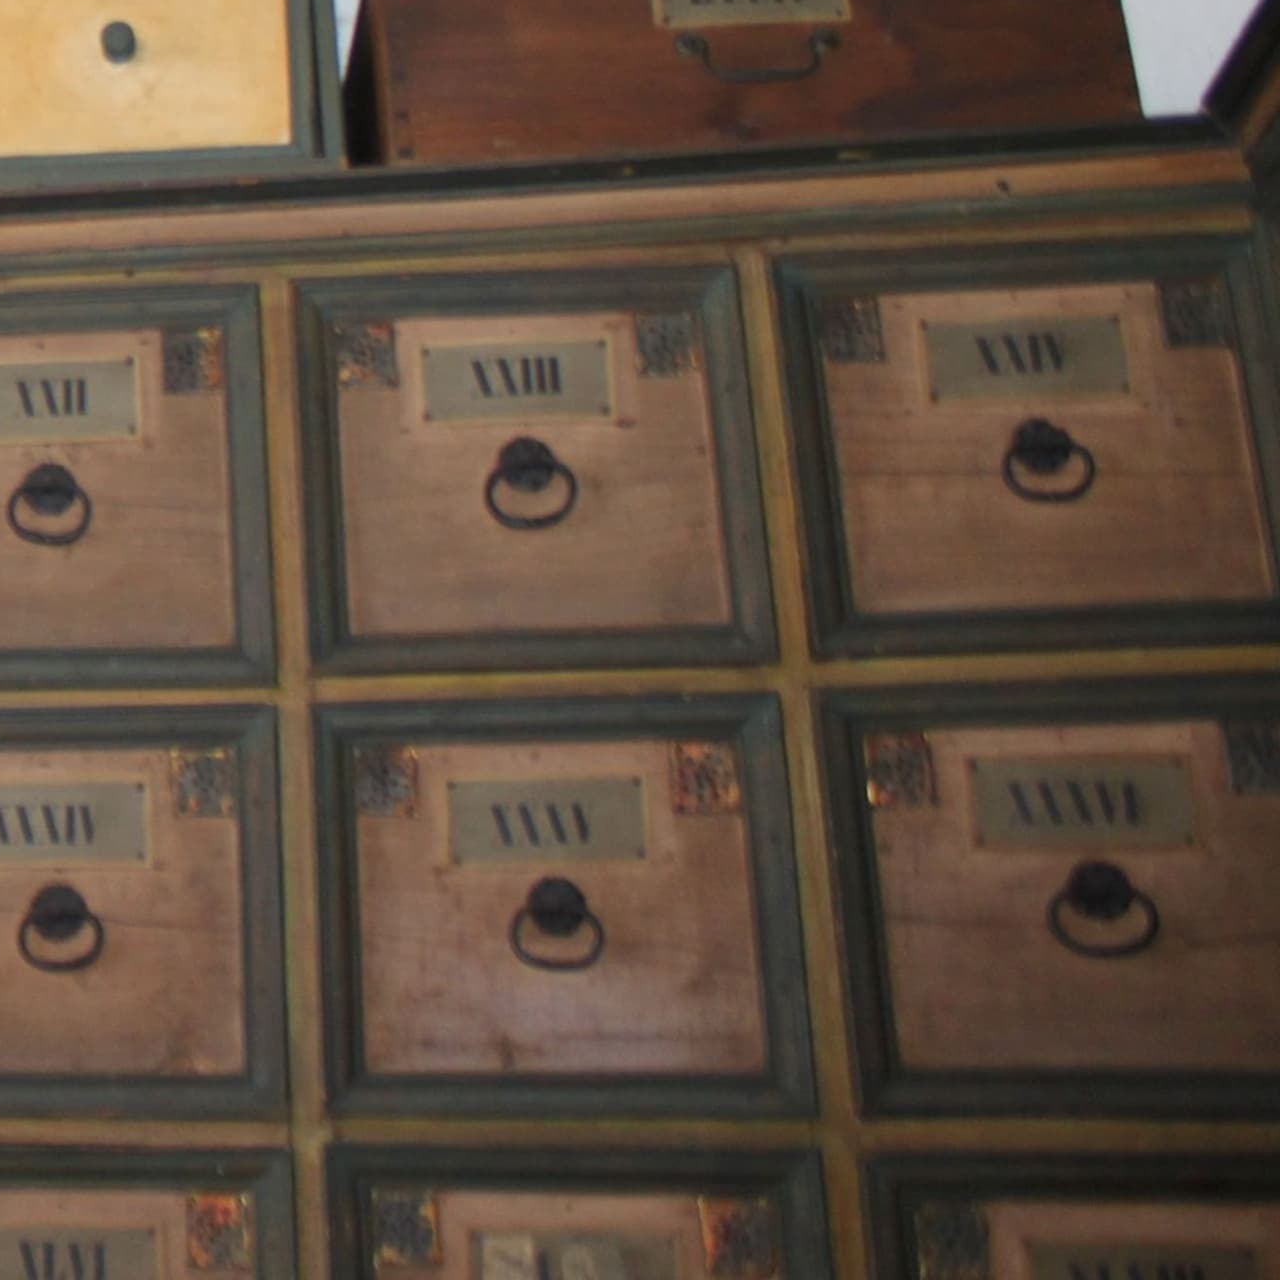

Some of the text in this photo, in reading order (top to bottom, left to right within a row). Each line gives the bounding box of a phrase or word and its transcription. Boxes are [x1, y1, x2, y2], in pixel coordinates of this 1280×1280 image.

[975, 332, 1068, 375] XXIV
[15, 378, 88, 417] XXII
[471, 355, 562, 398] XXIII
[490, 801, 598, 848] XXXV
[1007, 779, 1142, 827] XXXVI
